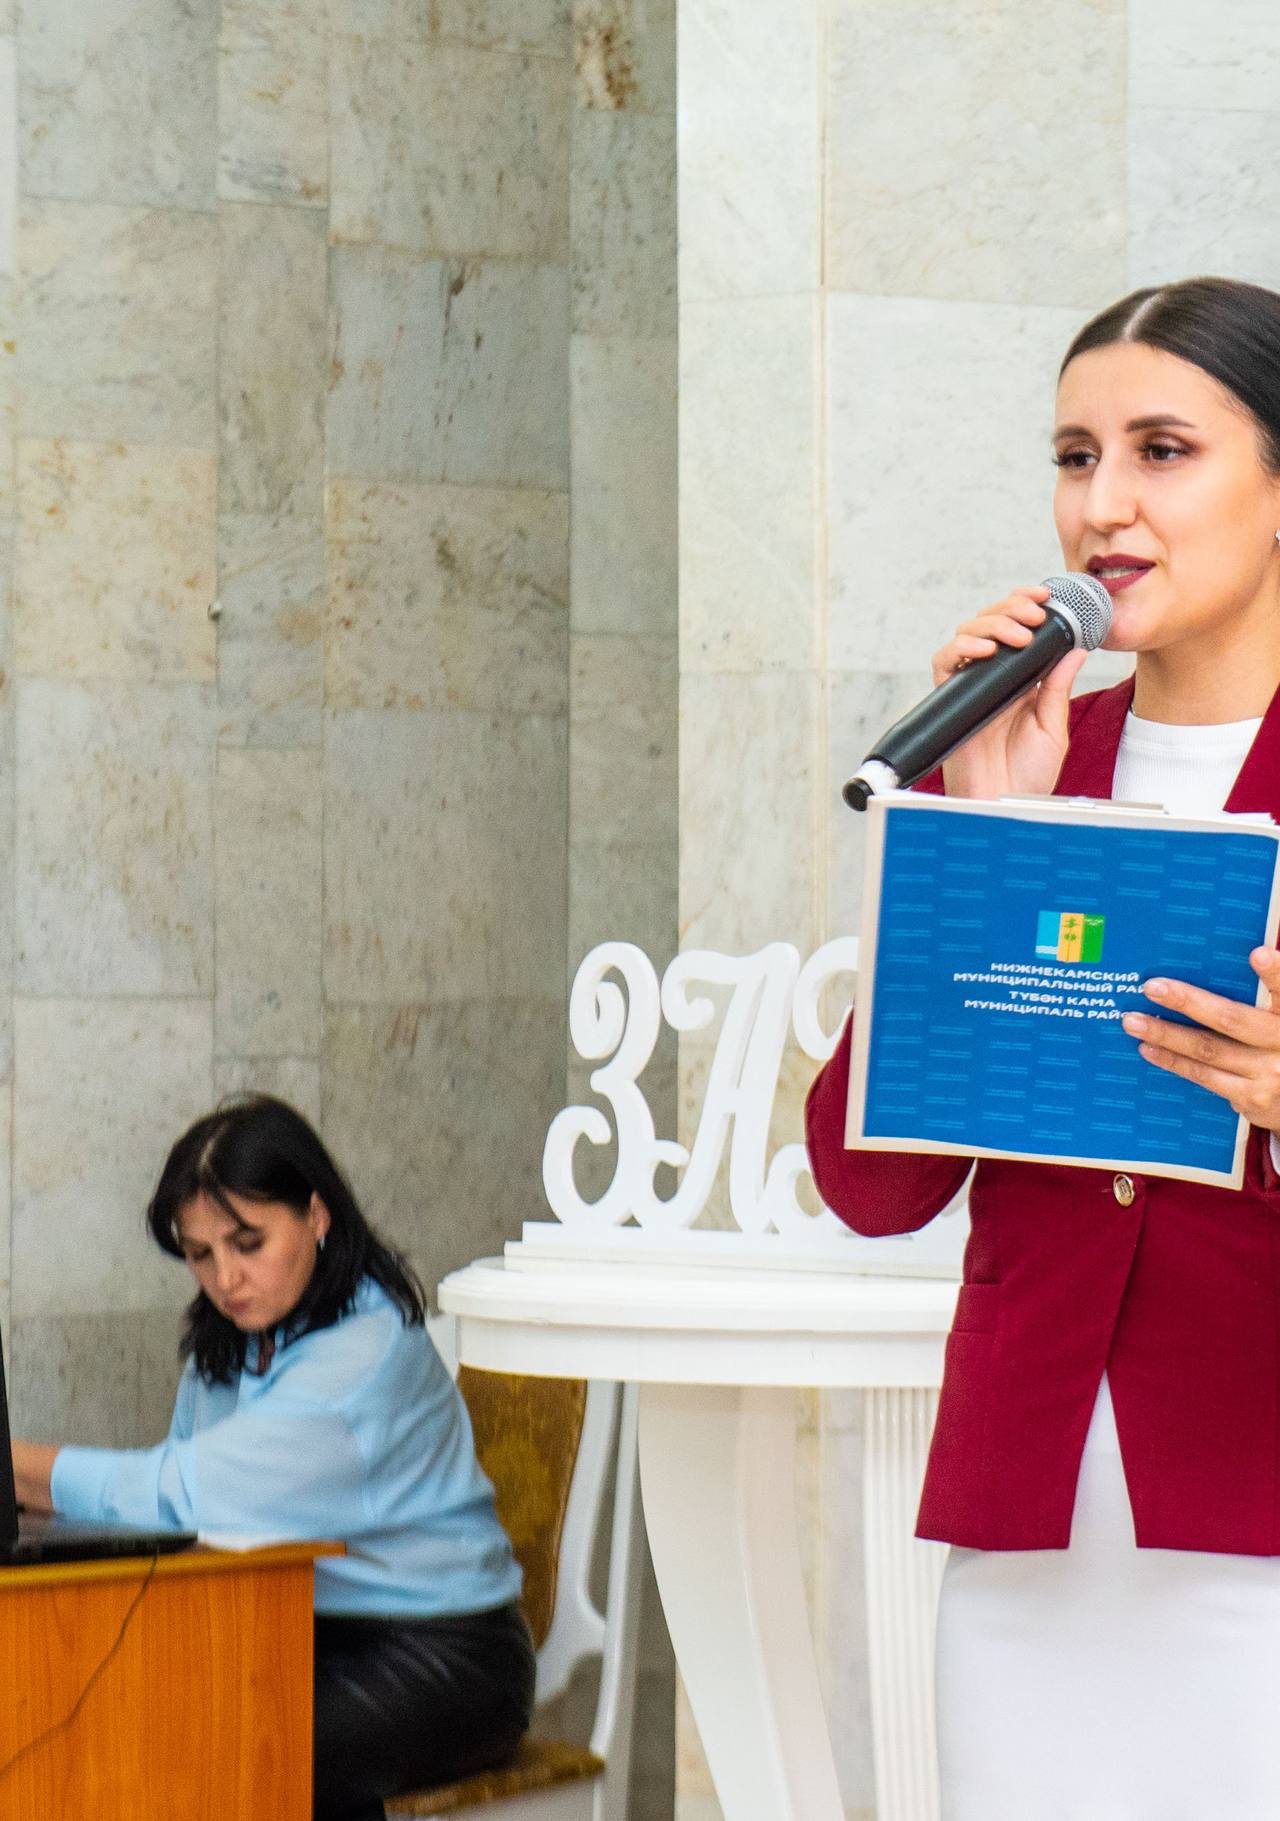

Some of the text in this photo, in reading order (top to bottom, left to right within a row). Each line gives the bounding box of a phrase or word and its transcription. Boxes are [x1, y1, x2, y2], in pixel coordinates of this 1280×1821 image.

[990, 963, 1139, 982] НИЖНЕКАМСКИЙ
[953, 973, 1113, 993] МУНИЦИПАЛЬНЫЙ
[964, 1000, 1084, 1018] МУНИЦИПАЛЬ
[1067, 997, 1116, 1008] КАМА
